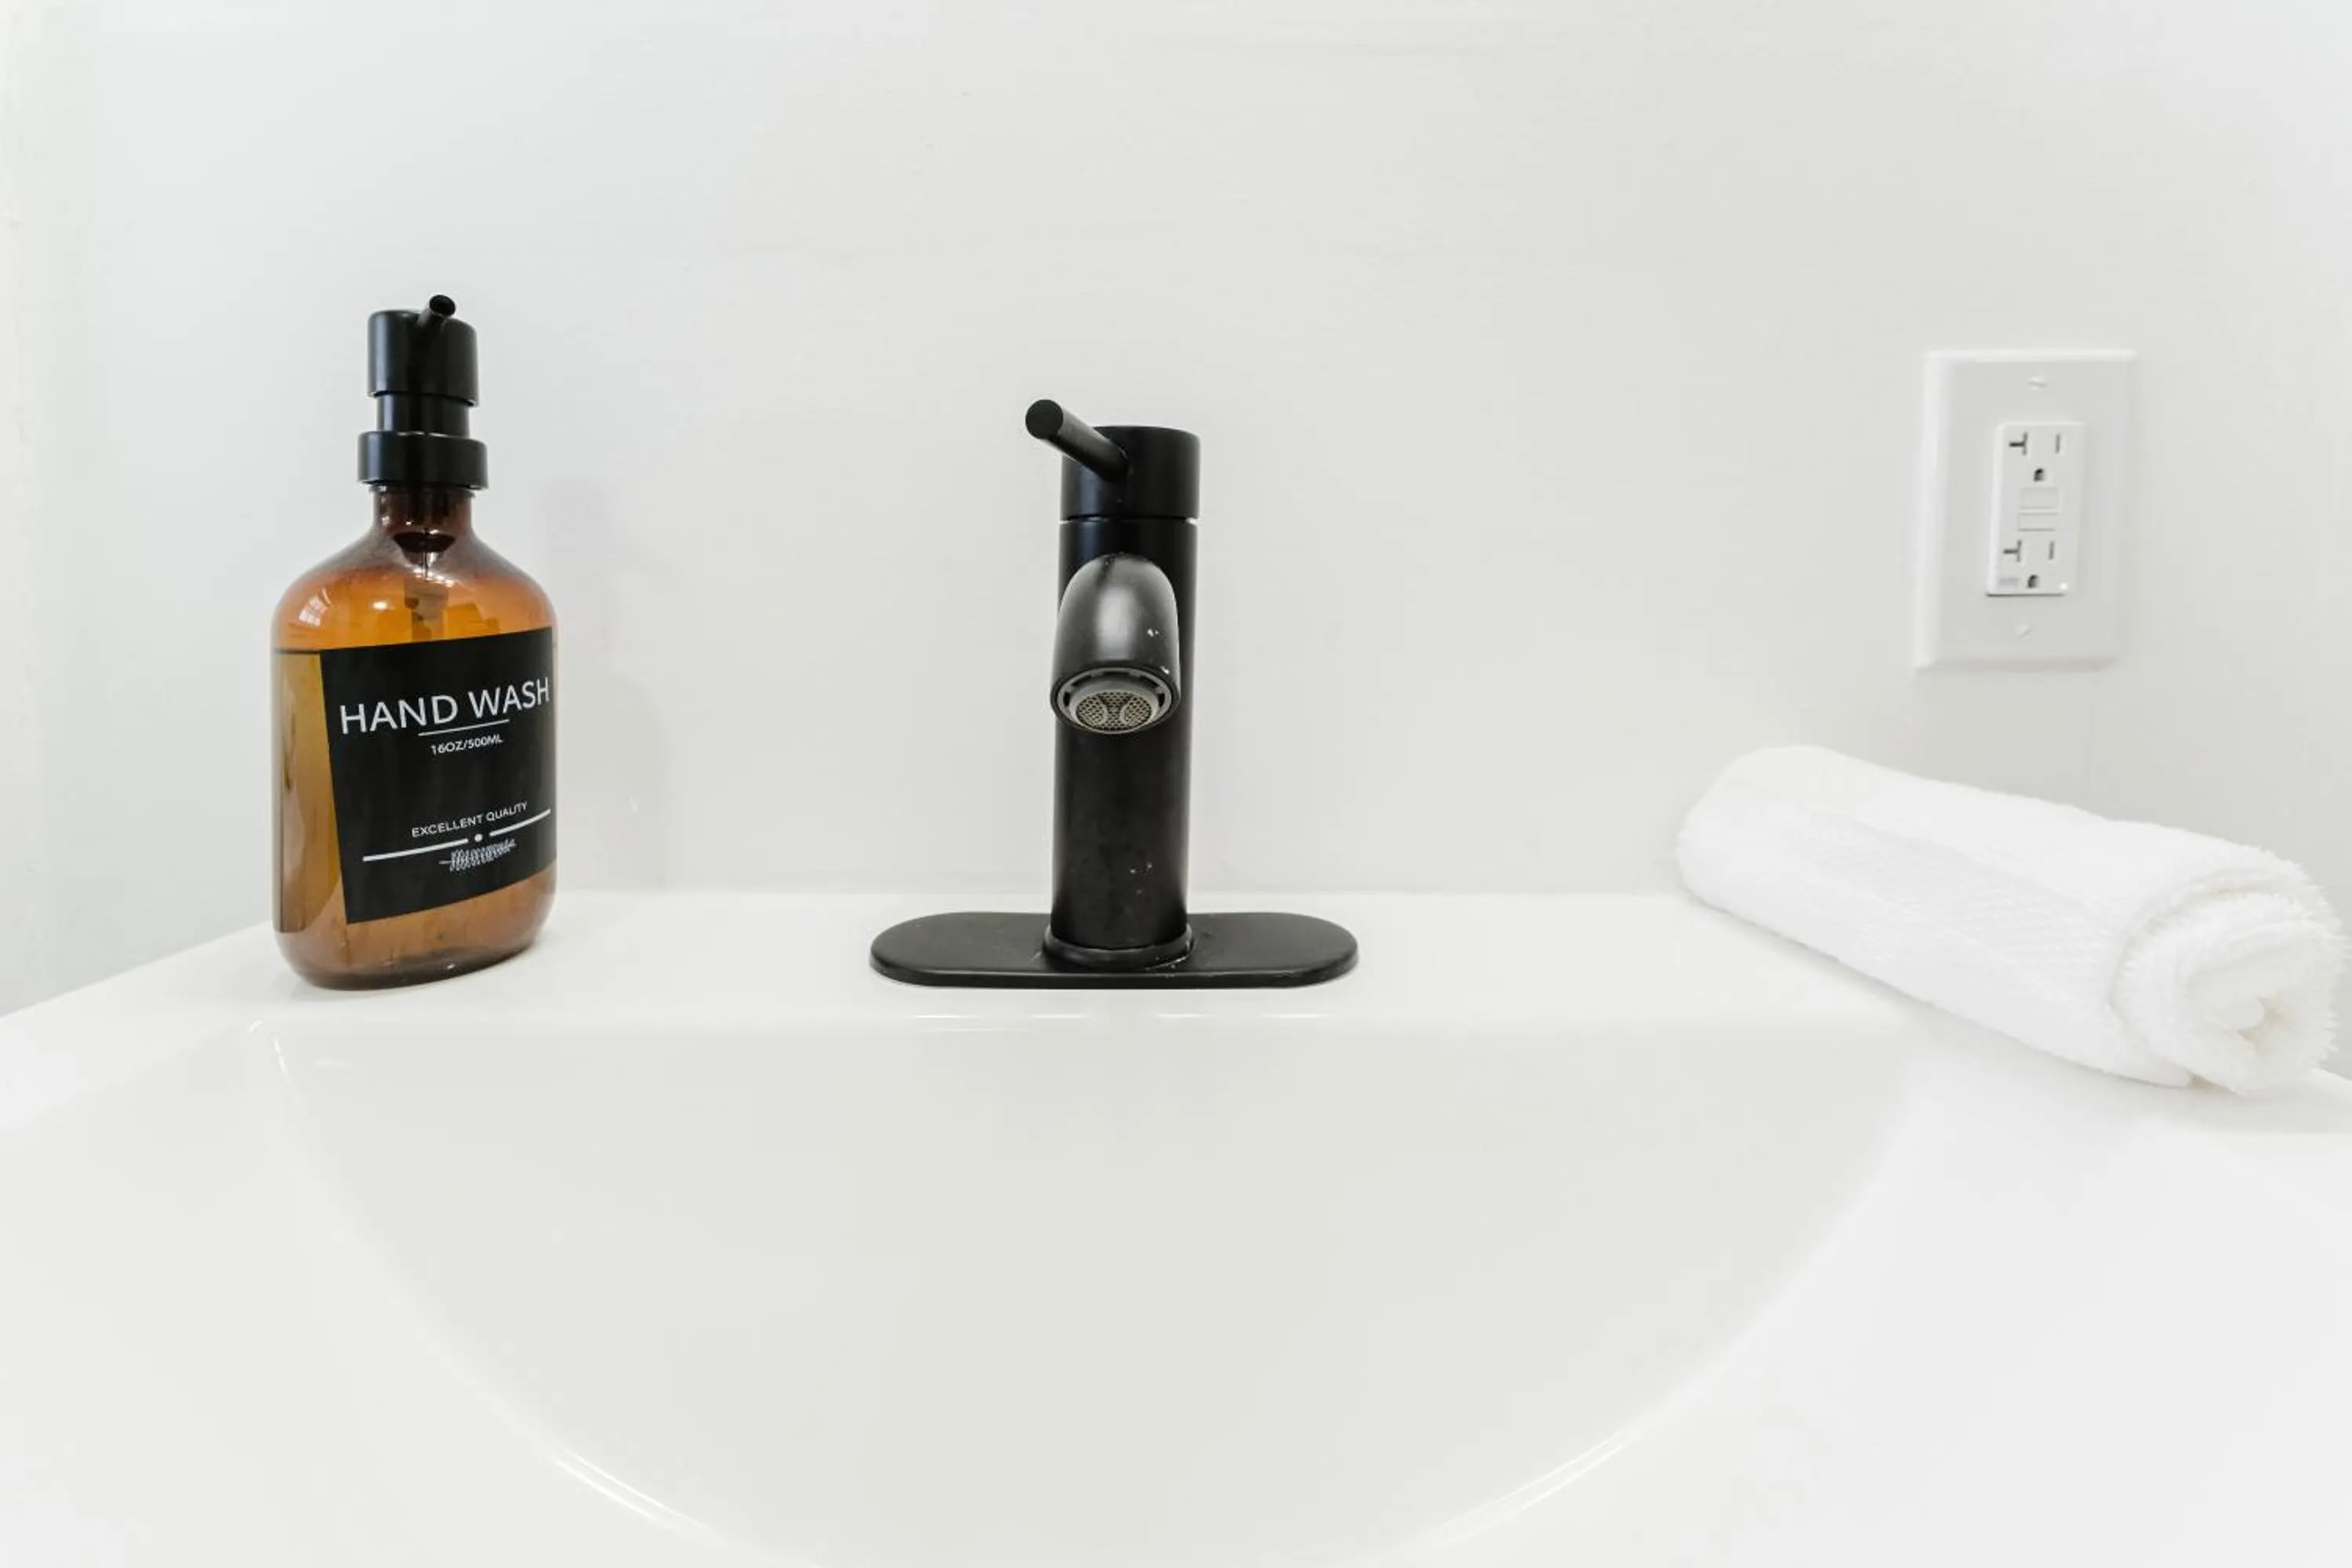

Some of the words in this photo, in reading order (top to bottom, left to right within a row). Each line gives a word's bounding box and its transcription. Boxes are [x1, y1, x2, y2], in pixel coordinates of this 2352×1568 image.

[340, 695, 459, 735] HAND
[468, 677, 550, 719] WASH
[430, 734, 503, 755] 16OZ/500ML
[412, 814, 484, 838] EXCELLENT
[485, 800, 528, 822] QUALITY
